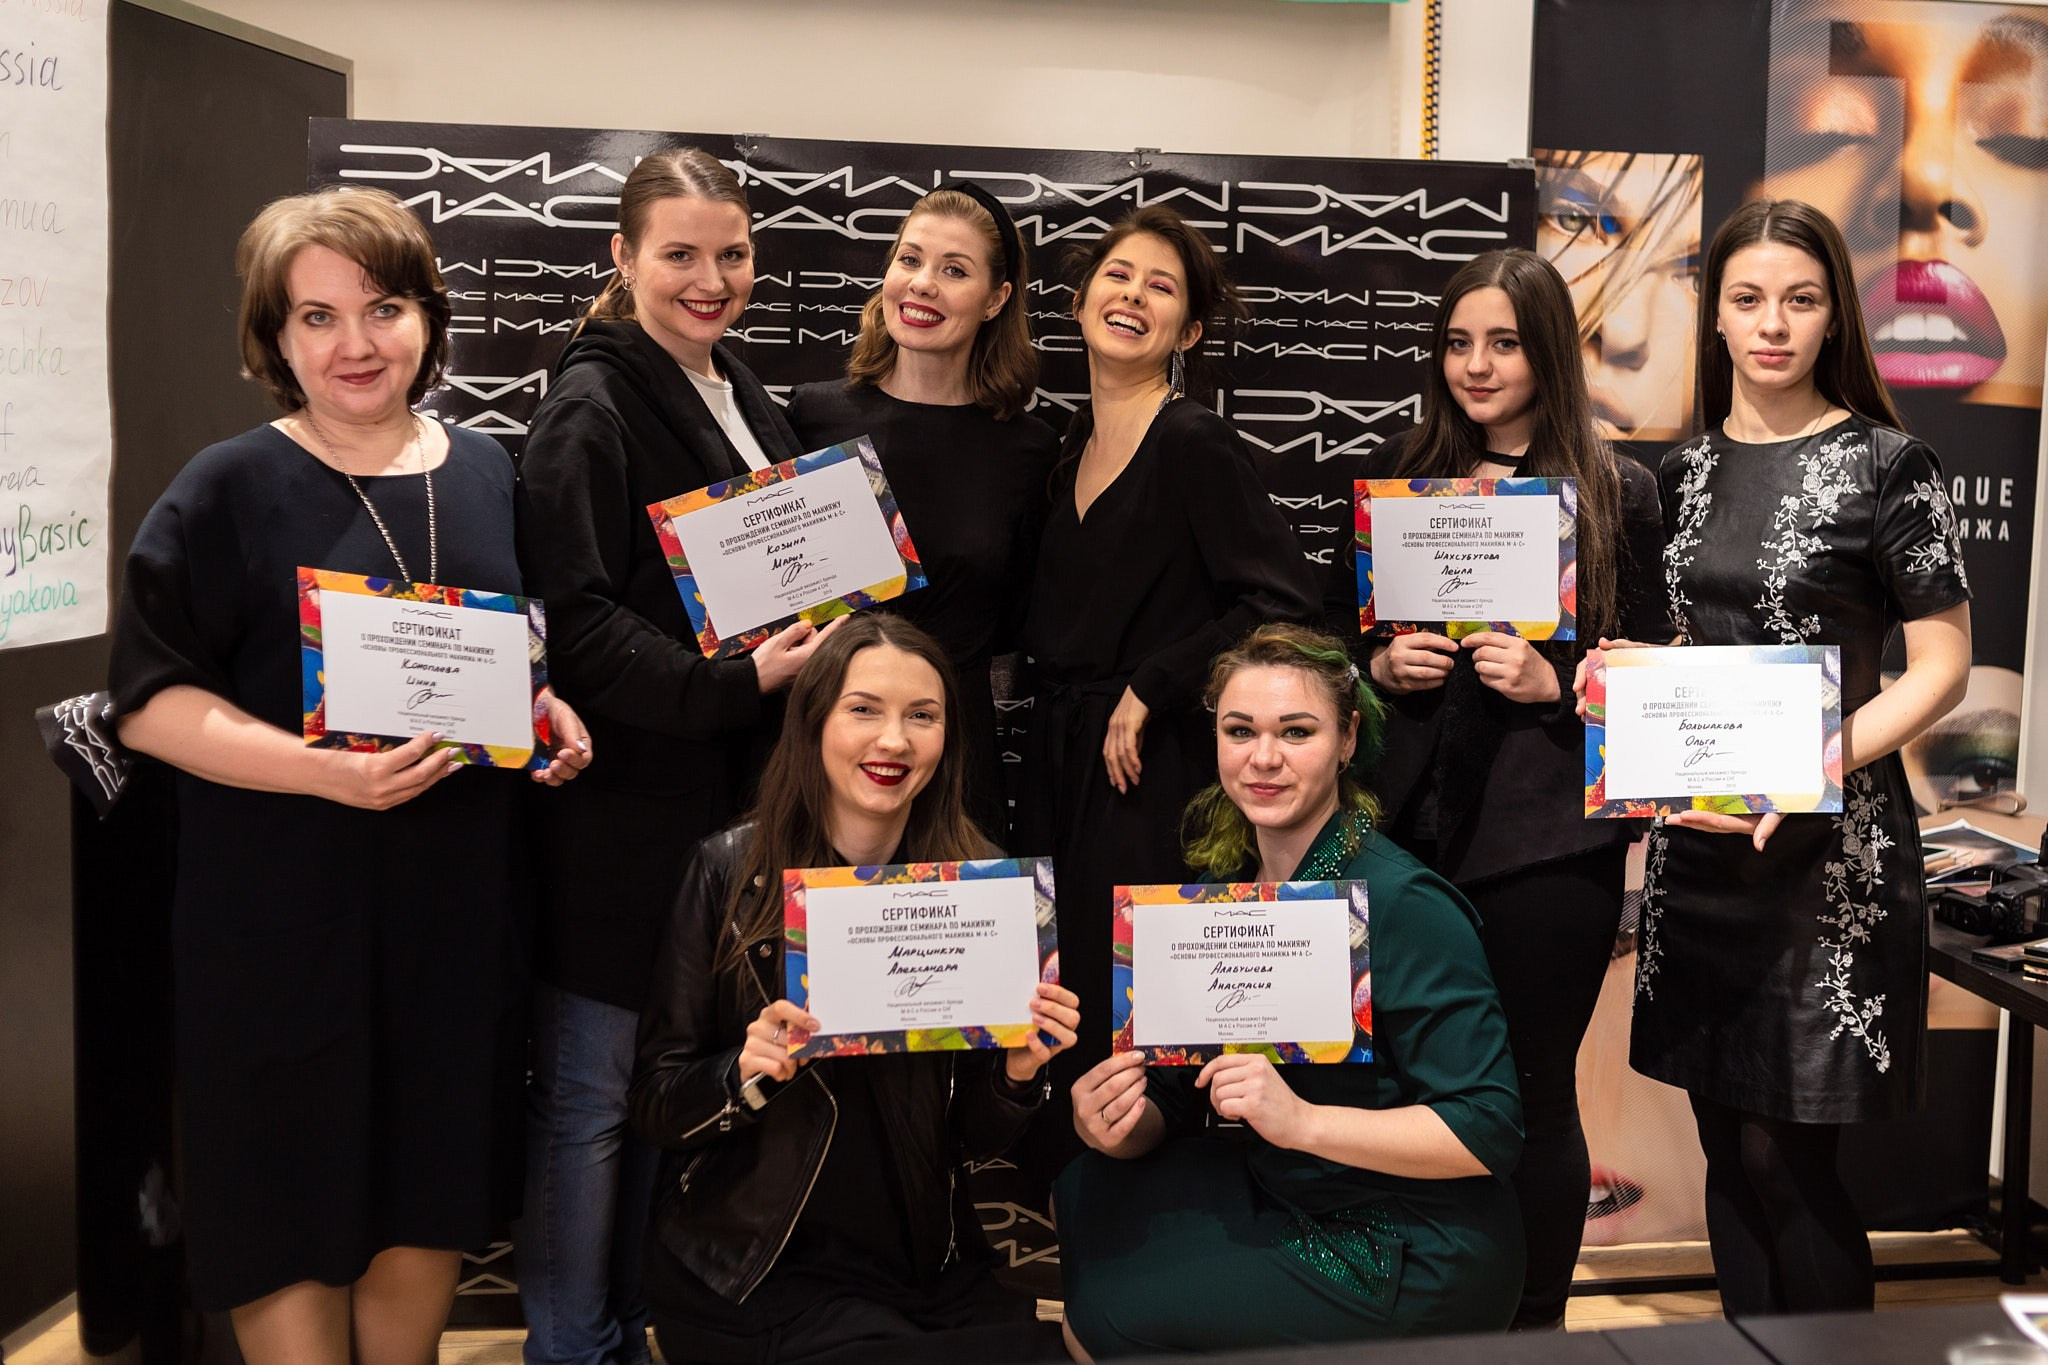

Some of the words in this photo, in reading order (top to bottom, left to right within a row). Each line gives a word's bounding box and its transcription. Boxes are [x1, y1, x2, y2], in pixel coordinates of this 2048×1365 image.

[1237, 181, 1509, 223] MAC
[1237, 221, 1509, 261] MAC
[494, 292, 564, 304] MAC
[1235, 285, 1370, 306] MAC
[1234, 317, 1299, 327] MAC
[1304, 319, 1369, 330] MAC
[1233, 340, 1368, 360] MAC
[746, 487, 794, 507] MAC
[1952, 474, 2014, 509] QUE
[741, 497, 808, 528] СЕРТИФИКАТ
[724, 525, 770, 546] ПРОХОЖДЕНИИ
[769, 514, 802, 530] СЕМИНАРА
[802, 510, 812, 519] ПО
[811, 500, 843, 516] МАКИЯЖУ
[1430, 516, 1492, 528] СЕРТИФИКАТ
[1960, 517, 2011, 542] ЯЖА
[766, 536, 806, 555] Козина
[1649, 701, 1698, 709] ПРОХОЖДЕНИИ
[1679, 719, 1742, 731] Большакова
[1685, 735, 1716, 746] Ольга
[881, 904, 957, 920] СЕРТИФИКАТ
[855, 923, 907, 934] ПРОХОЖДЕНИИ
[909, 922, 946, 931] СЕМИНАРА
[949, 921, 958, 929] ПО
[960, 919, 996, 928] МАКИЯЖУ
[1203, 924, 1275, 938] СЕРТИФИКАТ
[1178, 941, 1227, 950] ПРОХОЖДЕНИИ
[1228, 940, 1264, 949] СЕМИНАРА
[1266, 940, 1275, 948] ПО
[1277, 939, 1311, 948] МАКИЯЖУ
[887, 962, 958, 975] Александра
[1210, 961, 1273, 975] Алабушева
[1208, 978, 1272, 992] Анастасия
